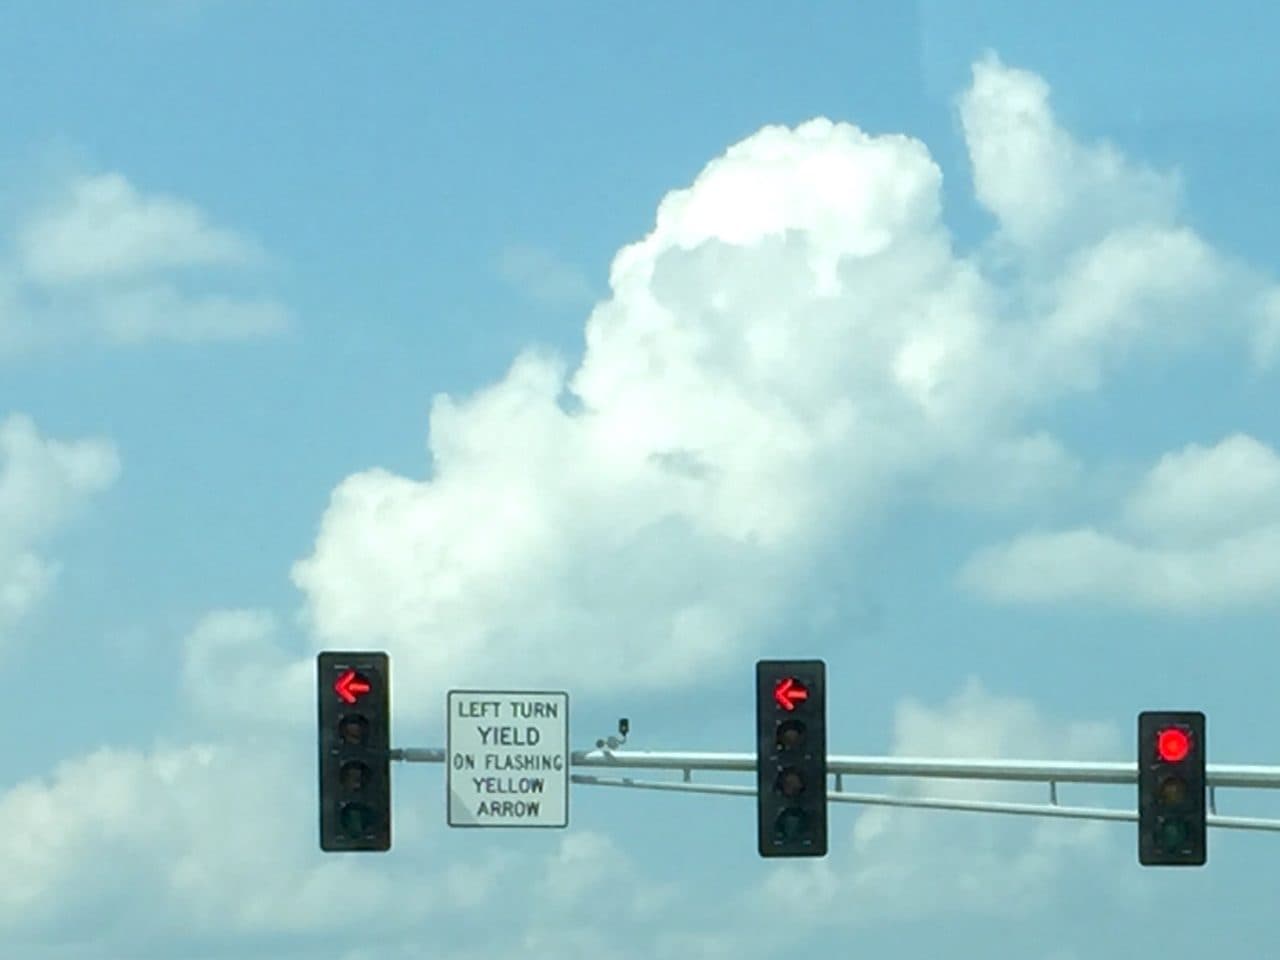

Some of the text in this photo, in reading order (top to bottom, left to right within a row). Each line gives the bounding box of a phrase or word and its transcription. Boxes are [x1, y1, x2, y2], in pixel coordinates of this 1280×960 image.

[459, 702, 558, 718] LEFT TURN
[477, 726, 540, 746] YIELD
[453, 752, 562, 771] ON FLASHING
[472, 777, 544, 794] YELLOW
[477, 801, 540, 817] ARROW
